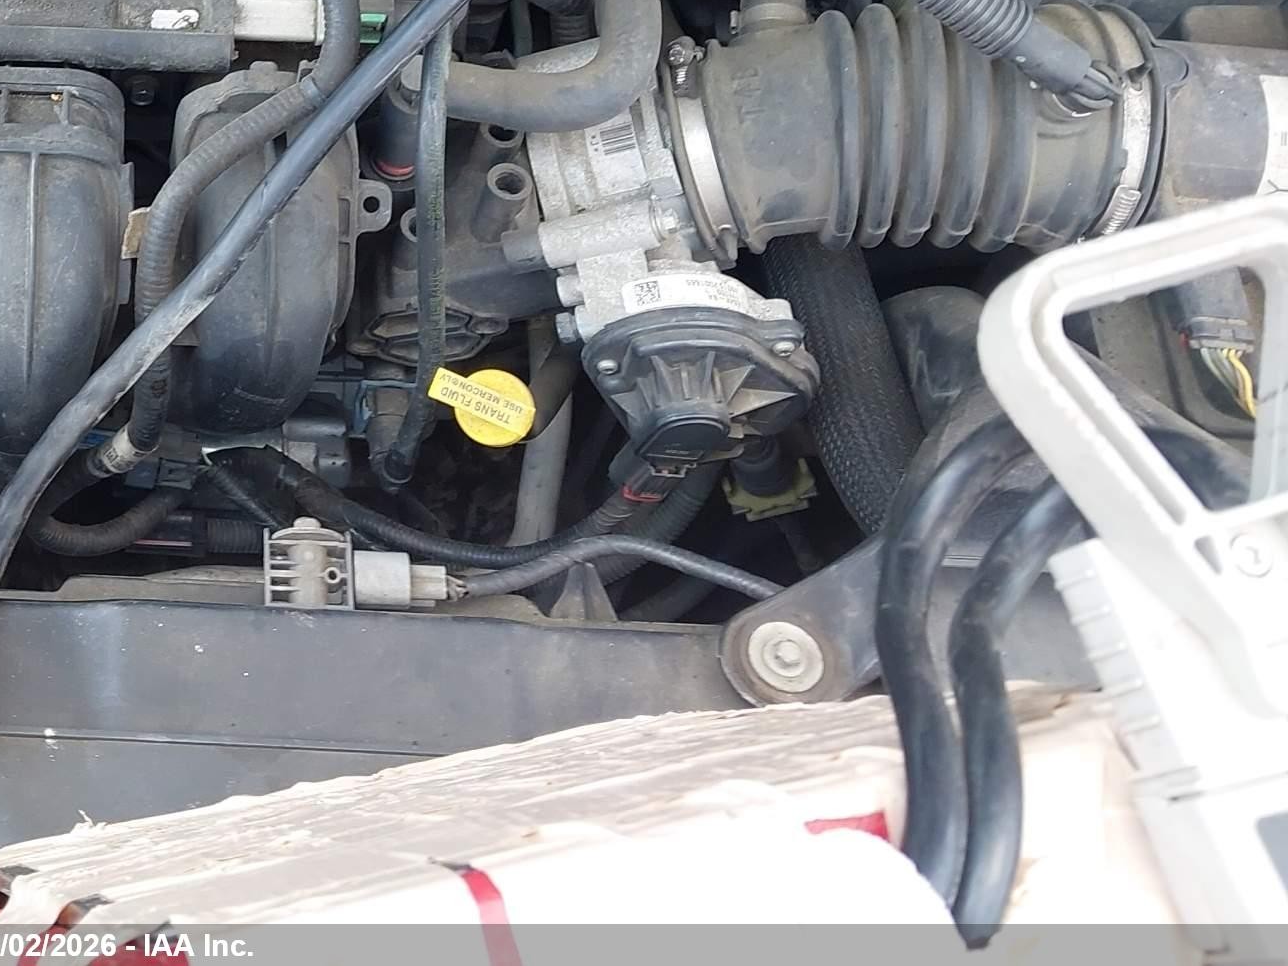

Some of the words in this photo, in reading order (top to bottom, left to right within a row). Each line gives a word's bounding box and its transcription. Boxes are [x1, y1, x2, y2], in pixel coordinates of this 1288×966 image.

[440, 386, 472, 407] FLUID
[503, 398, 524, 414] USE
[474, 401, 511, 425] TRANS
